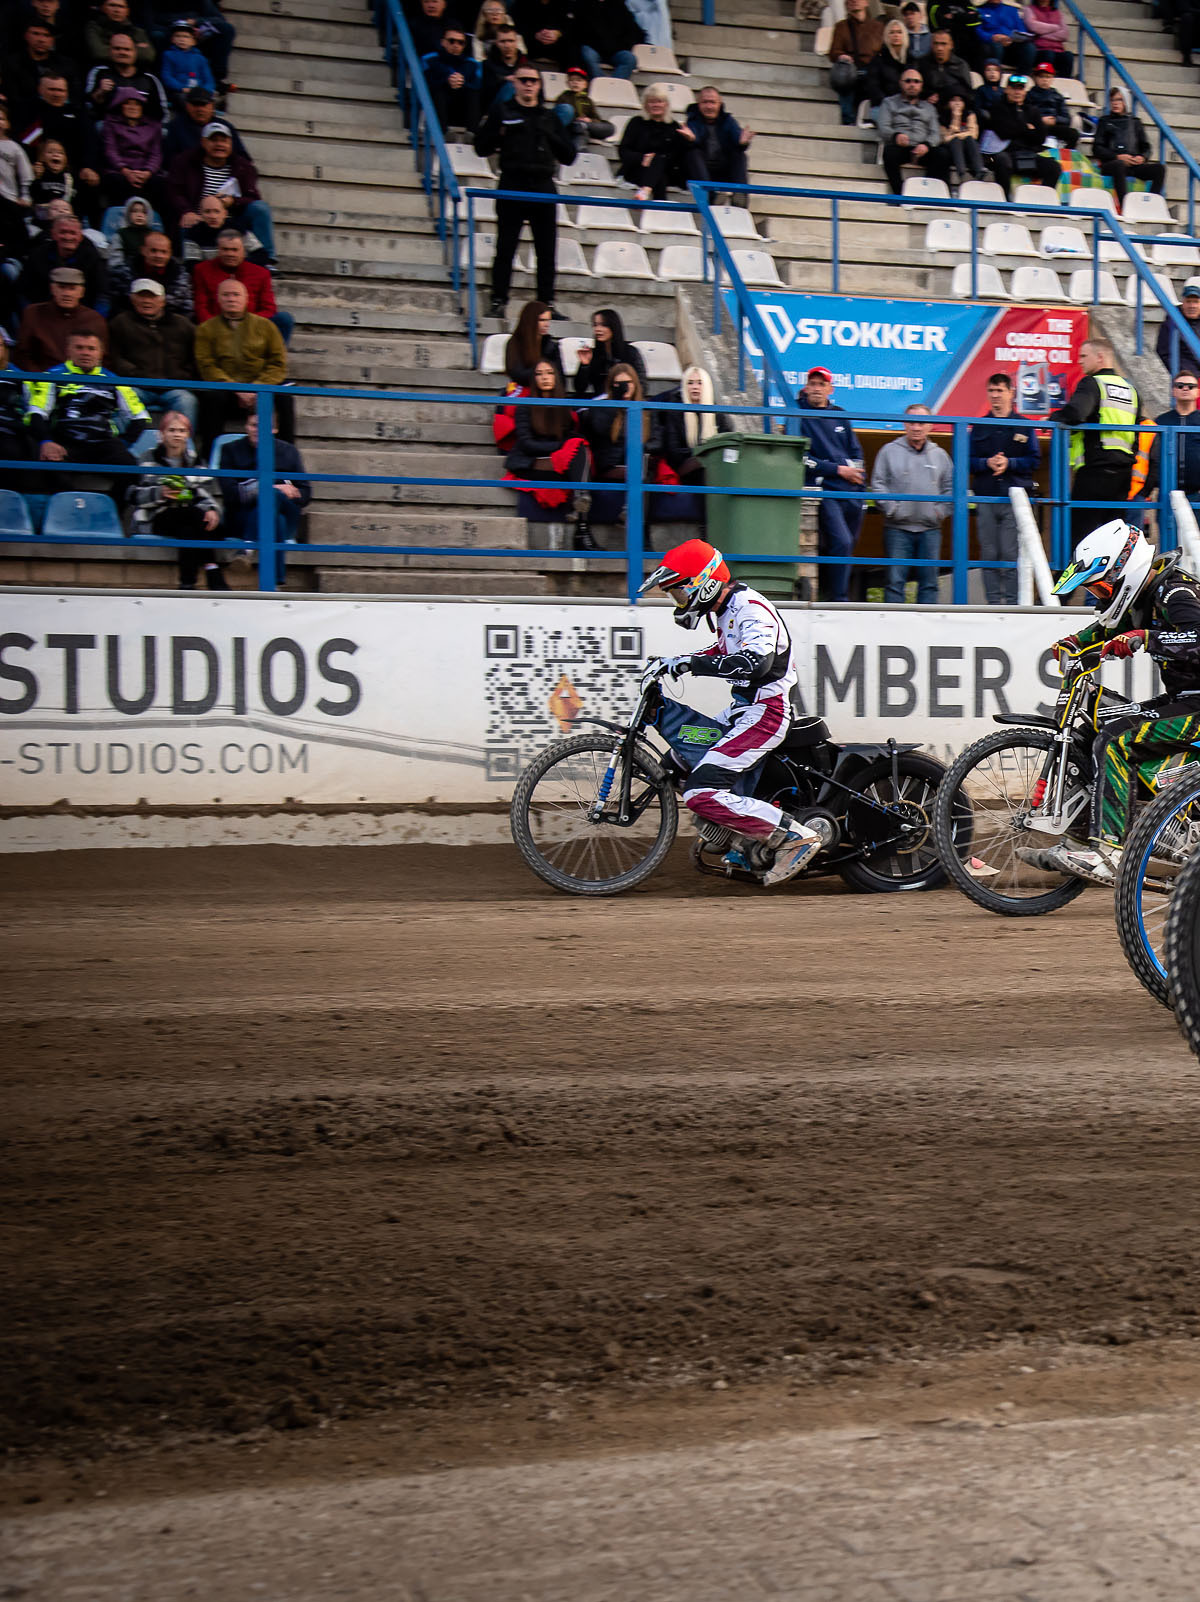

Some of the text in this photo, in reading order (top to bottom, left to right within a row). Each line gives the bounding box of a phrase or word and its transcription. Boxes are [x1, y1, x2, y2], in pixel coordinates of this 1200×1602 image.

[350, 312, 359, 325] 5
[1047, 318, 1073, 333] THE
[795, 318, 946, 352] STOKKER
[1006, 332, 1072, 348] ORIGINAL
[995, 348, 1073, 363] MOTOR OIL
[0, 632, 362, 716] STUDIOS
